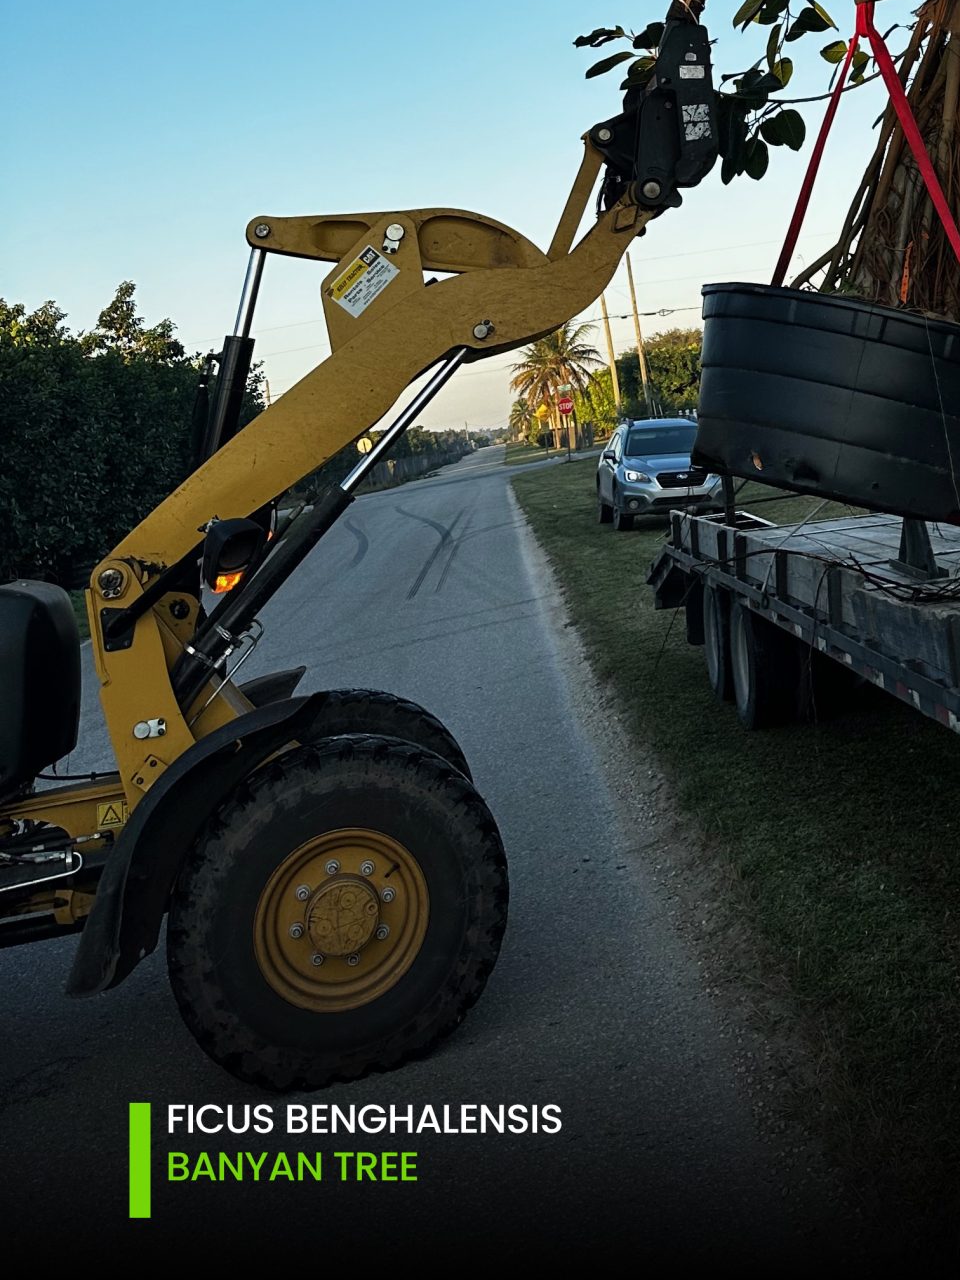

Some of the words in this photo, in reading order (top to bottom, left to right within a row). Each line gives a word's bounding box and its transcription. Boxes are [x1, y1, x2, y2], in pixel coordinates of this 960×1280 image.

[363, 250, 376, 264] CAT
[343, 280, 363, 300] Rentals
[347, 288, 363, 303] Parts
[559, 402, 573, 410] STOP
